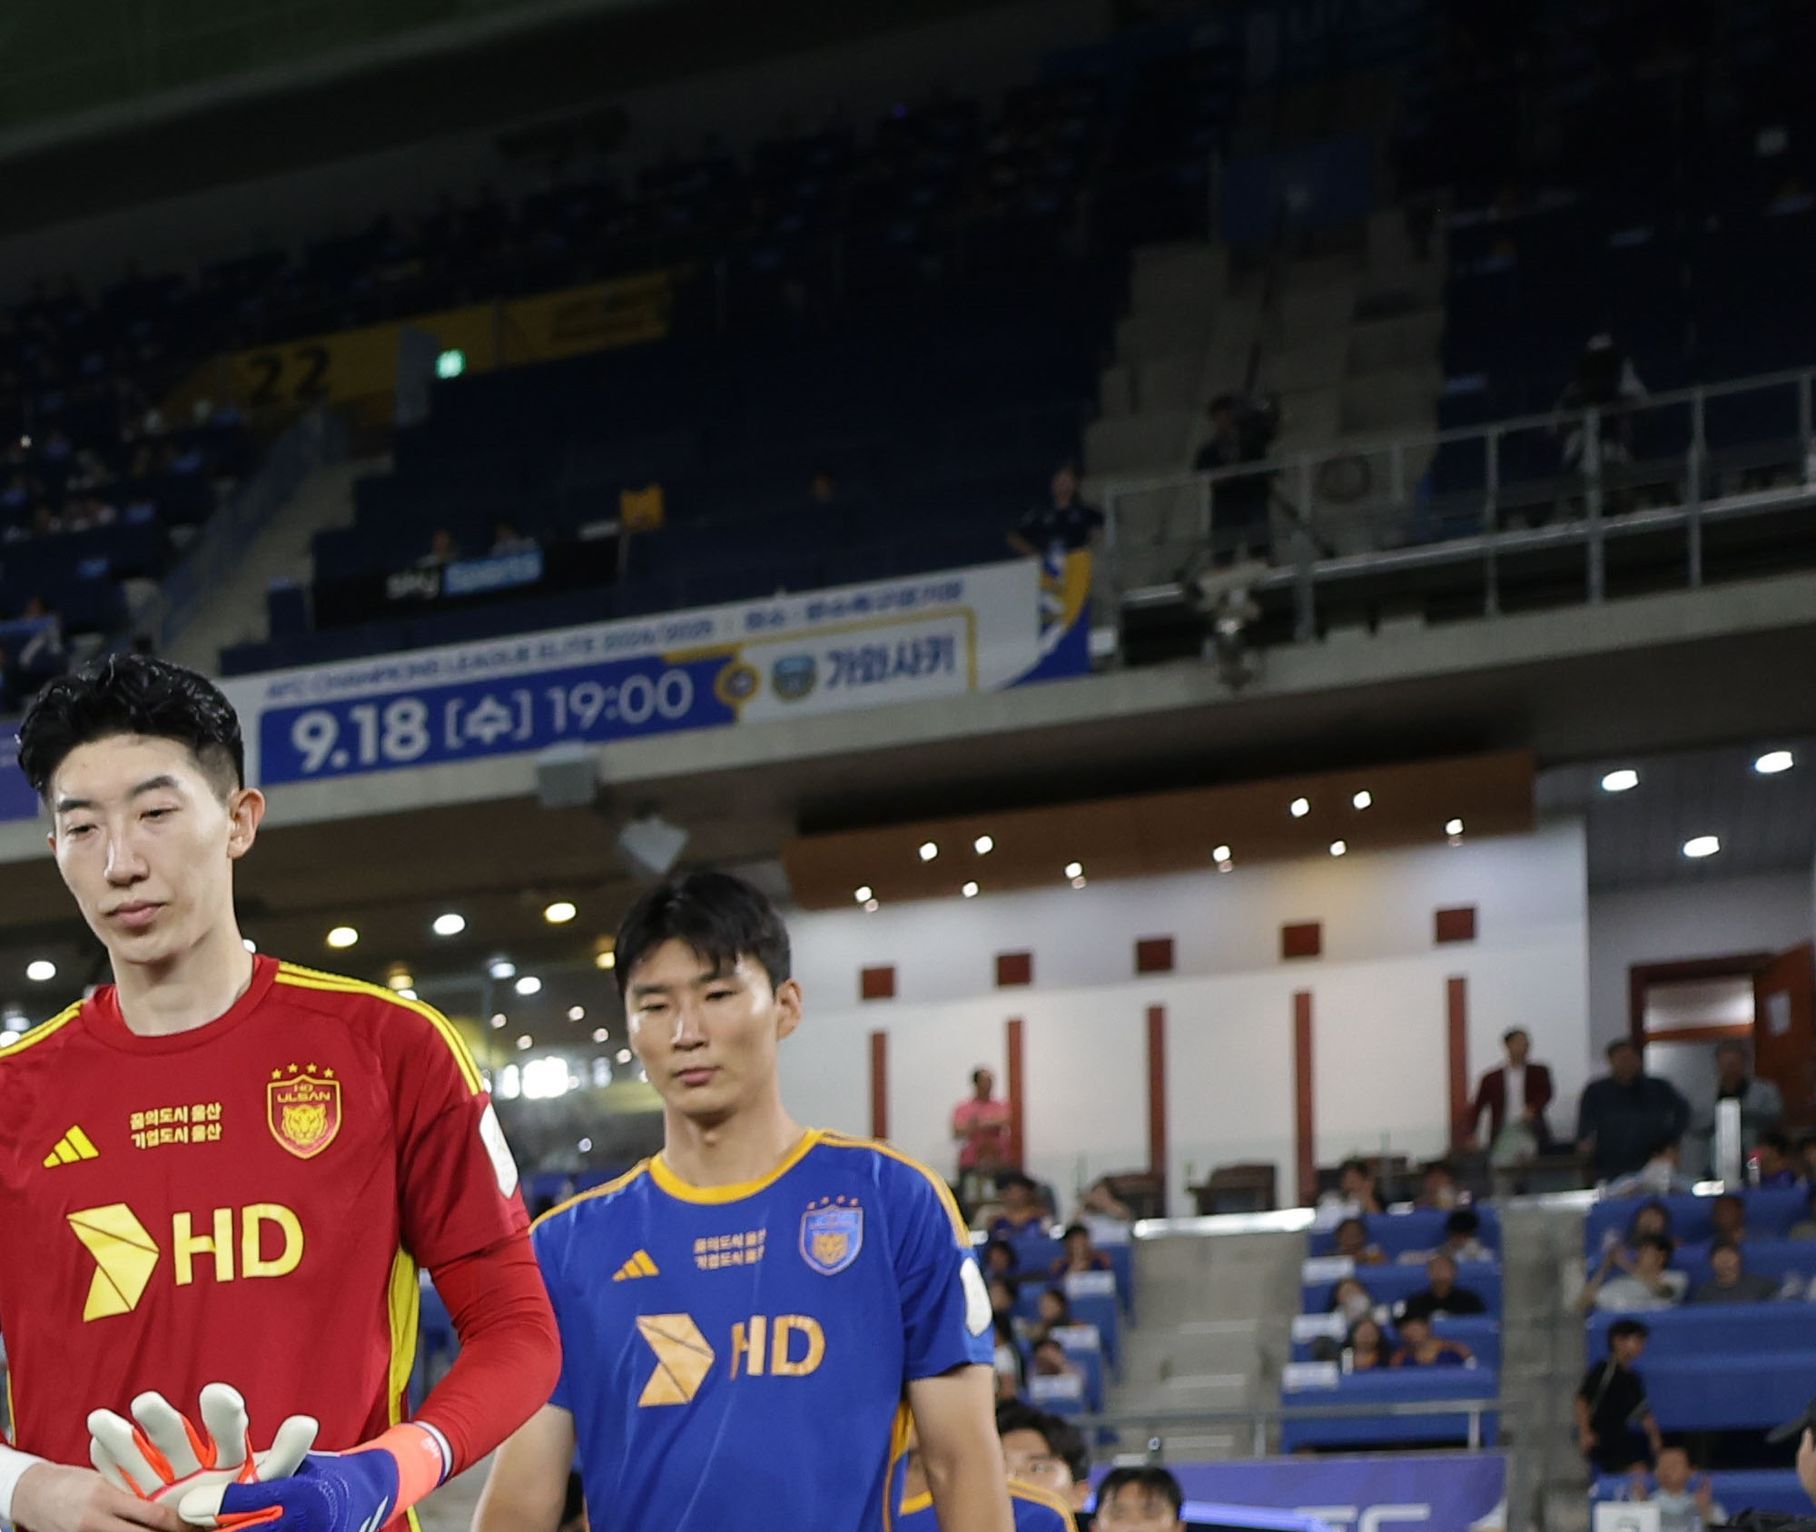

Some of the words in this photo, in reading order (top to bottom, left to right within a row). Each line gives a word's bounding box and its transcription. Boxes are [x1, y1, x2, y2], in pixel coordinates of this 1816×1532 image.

[825, 634, 955, 689] 가와사키
[291, 696, 430, 773] 9.18
[546, 668, 694, 733] 19:00
[276, 1091, 331, 1103] ULSAN
[172, 1202, 305, 1286] HD
[730, 1314, 826, 1382] HD
